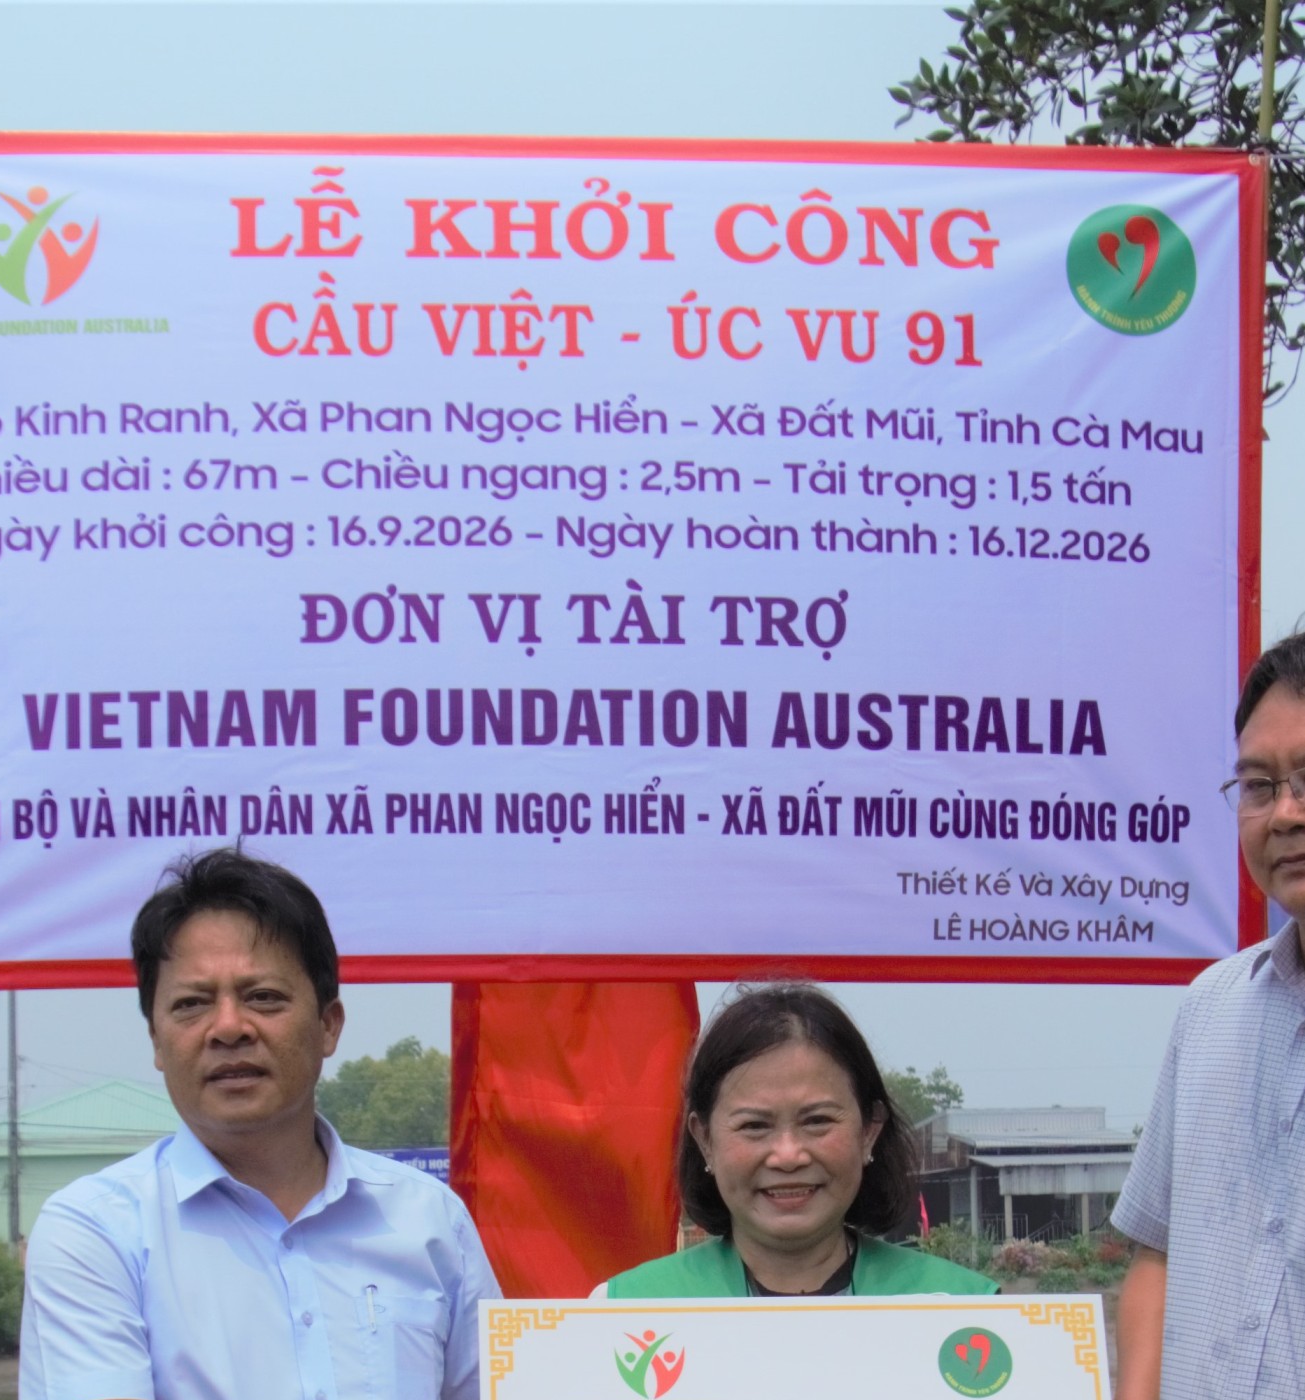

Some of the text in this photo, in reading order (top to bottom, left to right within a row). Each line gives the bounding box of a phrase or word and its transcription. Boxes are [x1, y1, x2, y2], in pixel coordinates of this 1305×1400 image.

[230, 167, 999, 269] LỄ KHỞI CÔNG
[84, 318, 169, 333] AUSTRALIA
[254, 272, 397, 357] CẦU
[422, 289, 594, 371] VIỆT
[667, 291, 762, 361] ÚC
[786, 309, 879, 363] VU
[906, 311, 982, 366] 91
[16, 402, 106, 436] Kinh
[121, 402, 237, 440] Ranh,
[254, 400, 306, 432] Xã
[321, 402, 431, 432] Phan
[446, 403, 561, 443] Ngọc
[575, 394, 667, 434] Hiển
[712, 404, 764, 436] Xã
[778, 399, 853, 438] Đất
[867, 408, 942, 445] Mũi,
[956, 409, 1040, 445] Tỉnh
[1052, 414, 1109, 448] Cà
[1122, 420, 1203, 454] Mau
[81, 457, 149, 491] dài
[184, 460, 277, 490] 67m
[322, 450, 448, 489] Chiều
[462, 465, 606, 501] ngang
[641, 461, 740, 495] 2,5m
[784, 460, 846, 494] Tải
[859, 466, 976, 509] trọng
[1008, 471, 1051, 505] 1,5
[1063, 466, 1131, 506] tấn
[75, 513, 166, 549] khởi
[179, 513, 293, 558] công
[328, 516, 512, 546] 16.9.2026
[557, 514, 673, 558] Ngày
[687, 516, 798, 550] hoàn
[811, 518, 937, 554] thành
[969, 526, 1150, 563] 16.12.2026
[300, 579, 848, 660] ĐƠN VỊ TÀI TRỢ
[24, 688, 1106, 755] VIETNAM FOUNDATION AUSTRALIA
[14, 789, 57, 848] BỘ
[71, 788, 116, 838] VÀ
[128, 787, 226, 837] NHÂN
[240, 786, 312, 836] DÂN
[326, 786, 373, 834] XÃ
[386, 794, 482, 833] PHAN
[496, 793, 591, 843] NGỌC
[605, 777, 684, 834] HIỂN
[722, 787, 767, 835] XÃ
[778, 781, 842, 836] ĐẤT
[854, 789, 916, 837] MŨI
[930, 790, 1018, 839] CÙNG
[1029, 793, 1116, 841] ĐÓNG
[1128, 795, 1190, 843] GÓP
[897, 867, 1189, 906] Thiết Kế Và Xây Dựng
[934, 913, 1153, 942] LÊ HOÀNG KHÂM
